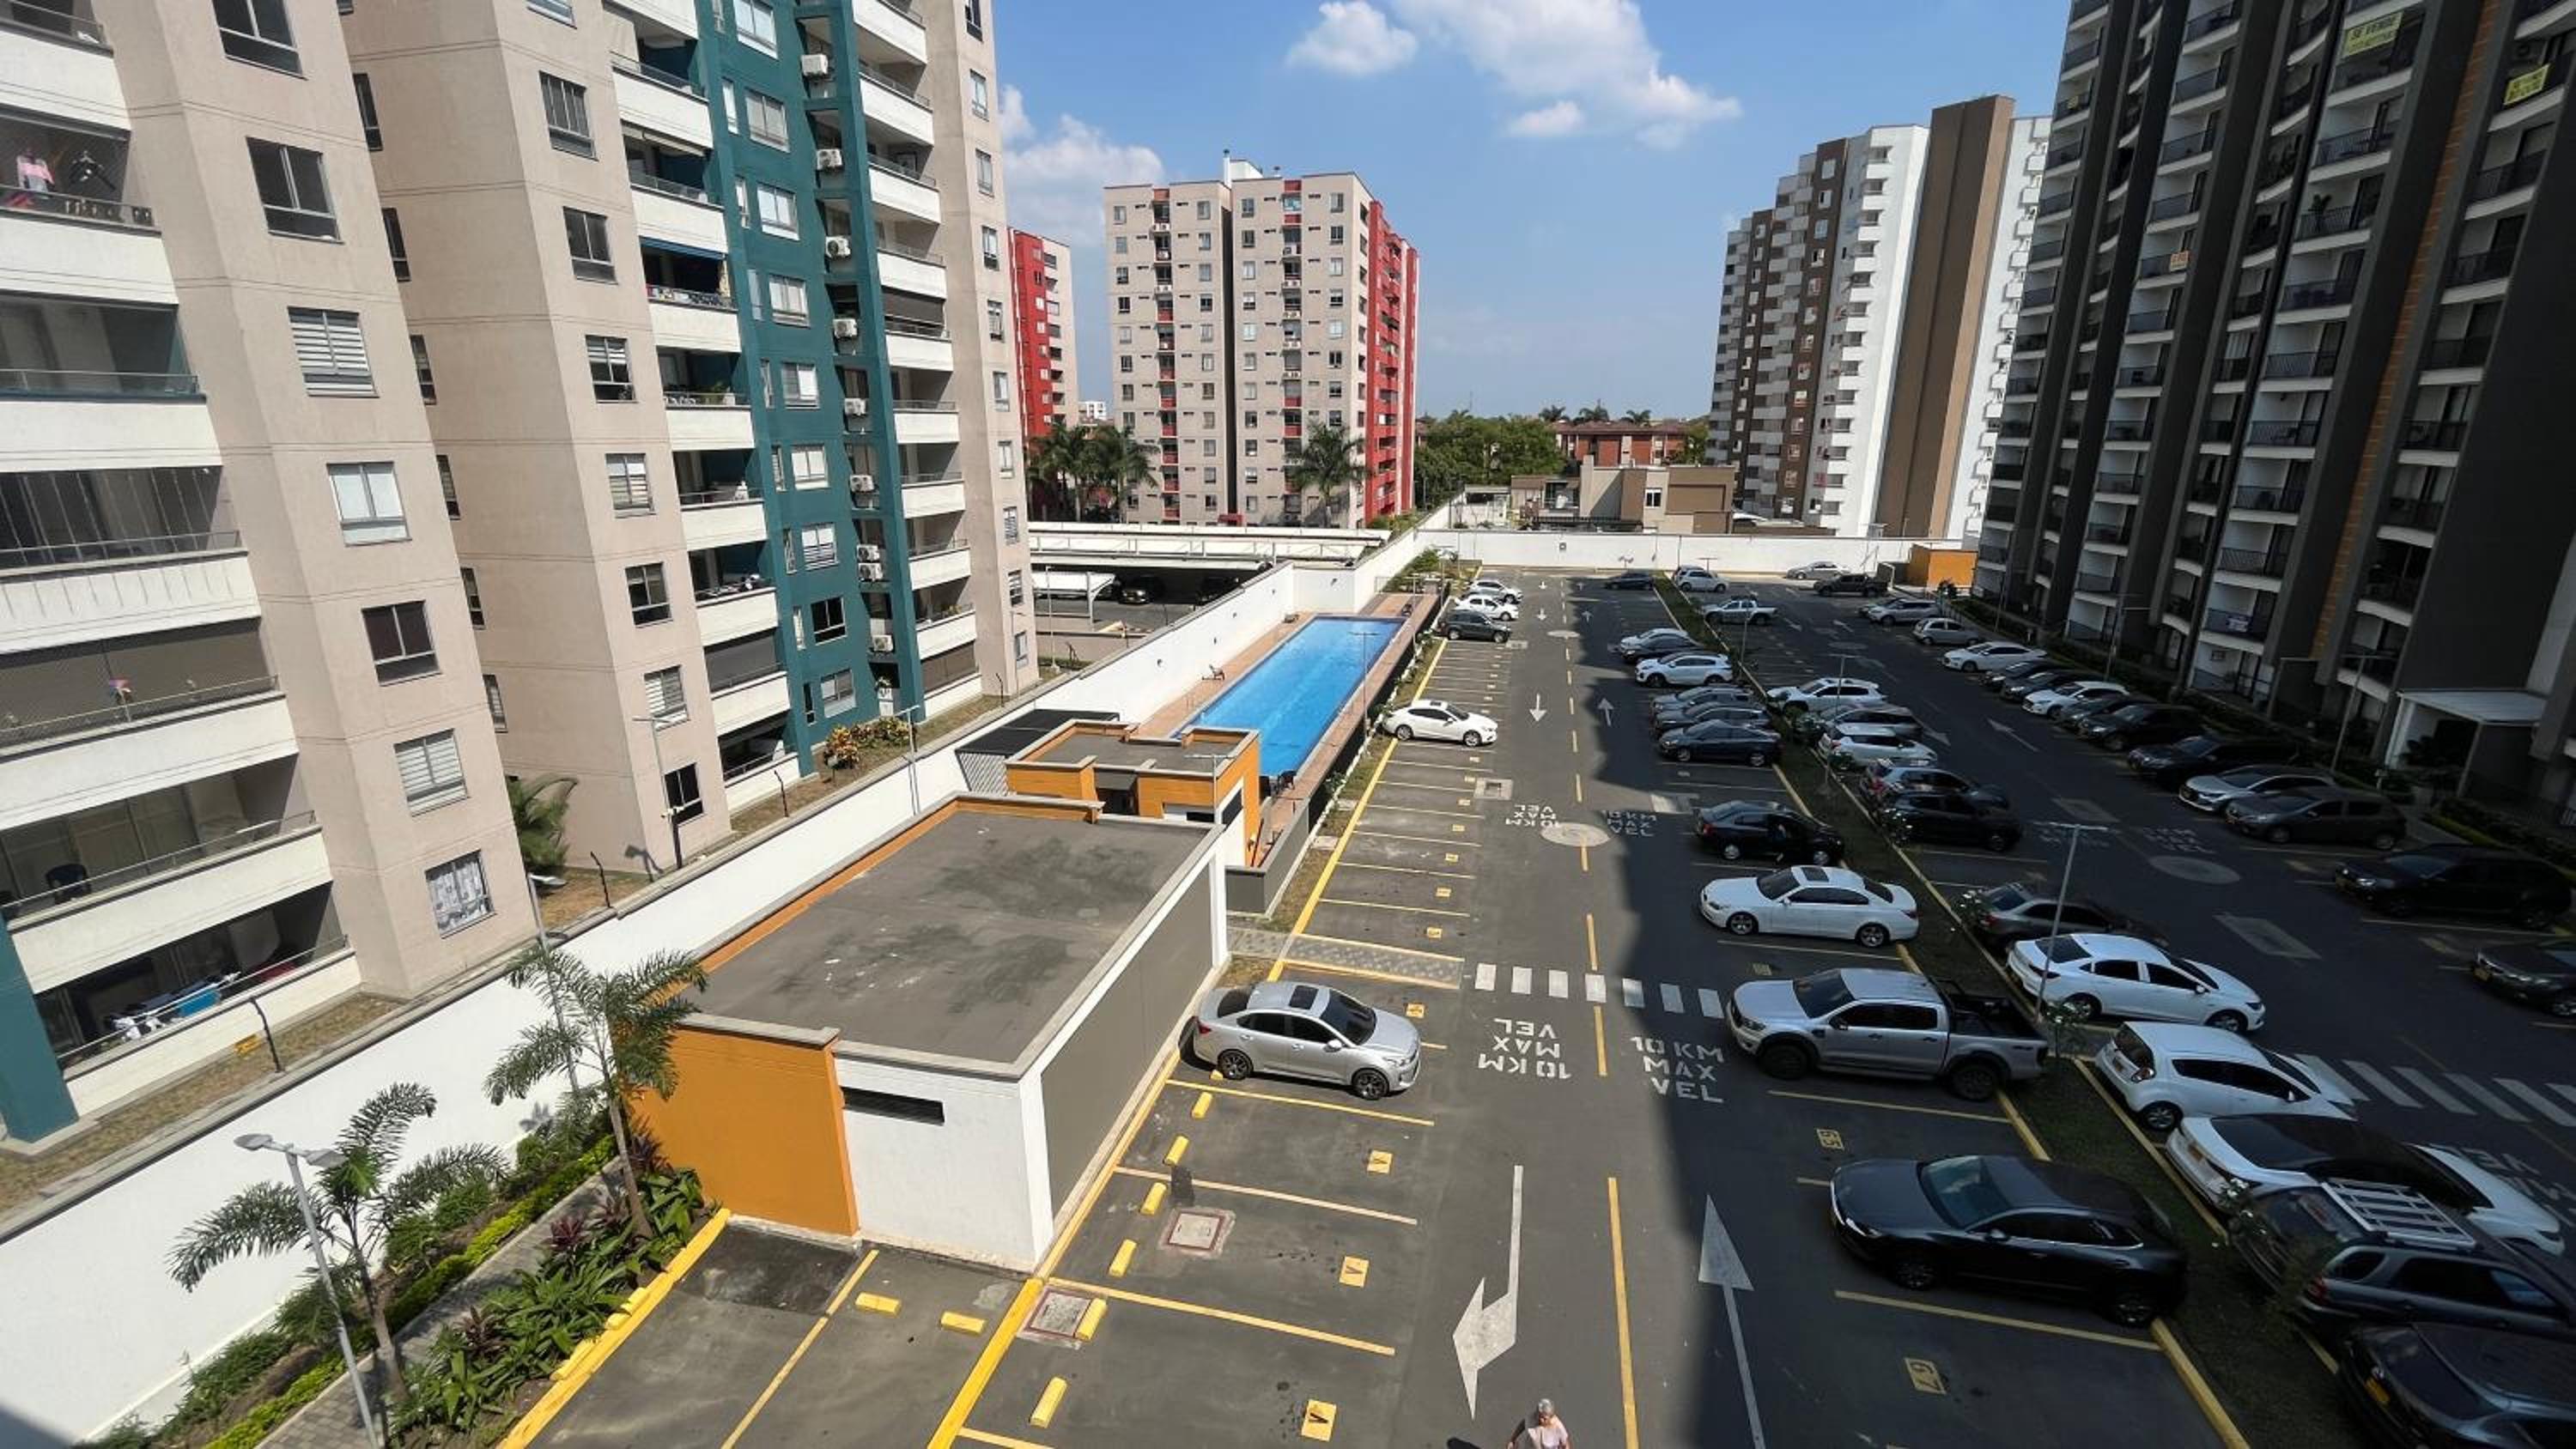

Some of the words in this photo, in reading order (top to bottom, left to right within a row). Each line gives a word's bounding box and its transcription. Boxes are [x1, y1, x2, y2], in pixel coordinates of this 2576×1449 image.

[1514, 804, 1553, 813] VEL
[1494, 1017, 1558, 1040] VEL
[1493, 1035, 1559, 1059] MAX
[1631, 1036, 1665, 1053] 10
[1674, 1041, 1724, 1063] KM
[1478, 1053, 1528, 1074] KM
[1537, 1061, 1572, 1079] 10
[1643, 1055, 1716, 1081] MAX
[1651, 1076, 1724, 1103] VEL
[1909, 1361, 1941, 1391] 67
